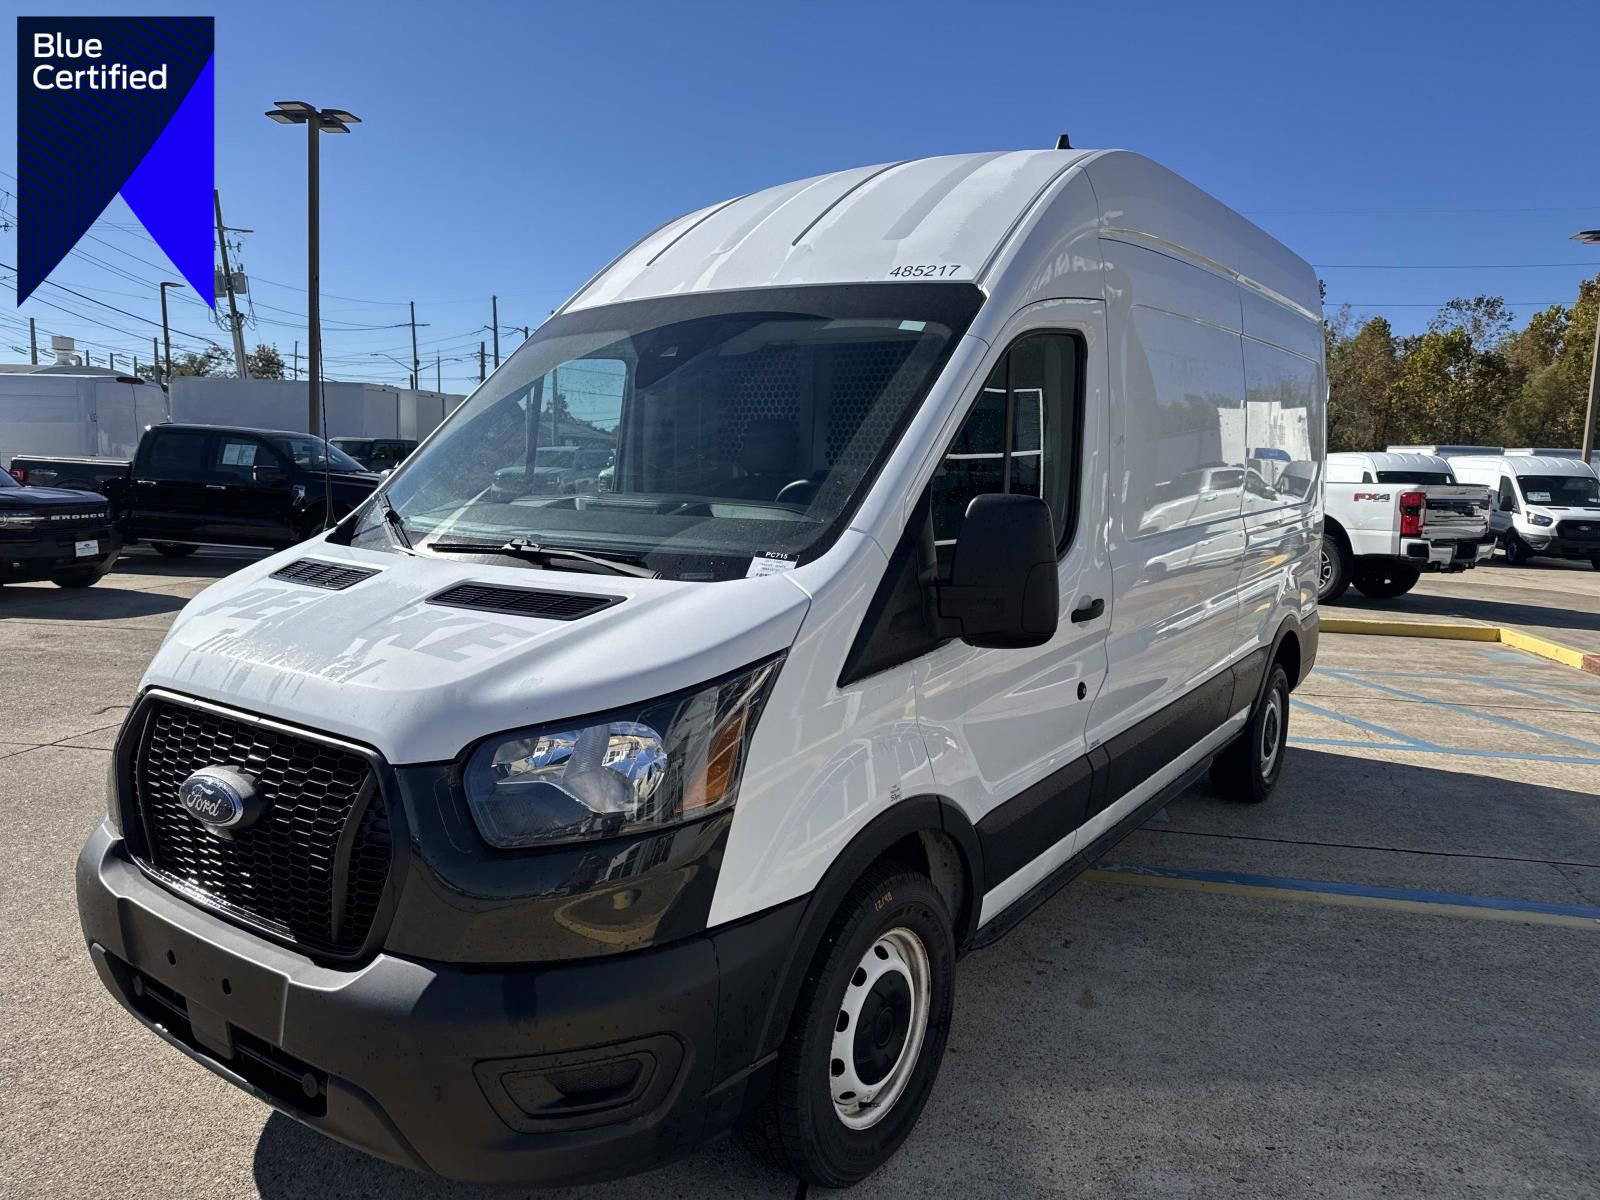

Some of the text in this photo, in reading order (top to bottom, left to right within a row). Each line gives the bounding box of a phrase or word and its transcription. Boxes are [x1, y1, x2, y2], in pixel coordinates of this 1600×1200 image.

[890, 265, 961, 277] 485217
[1353, 493, 1390, 502] FX4
[187, 784, 221, 817] Ford
